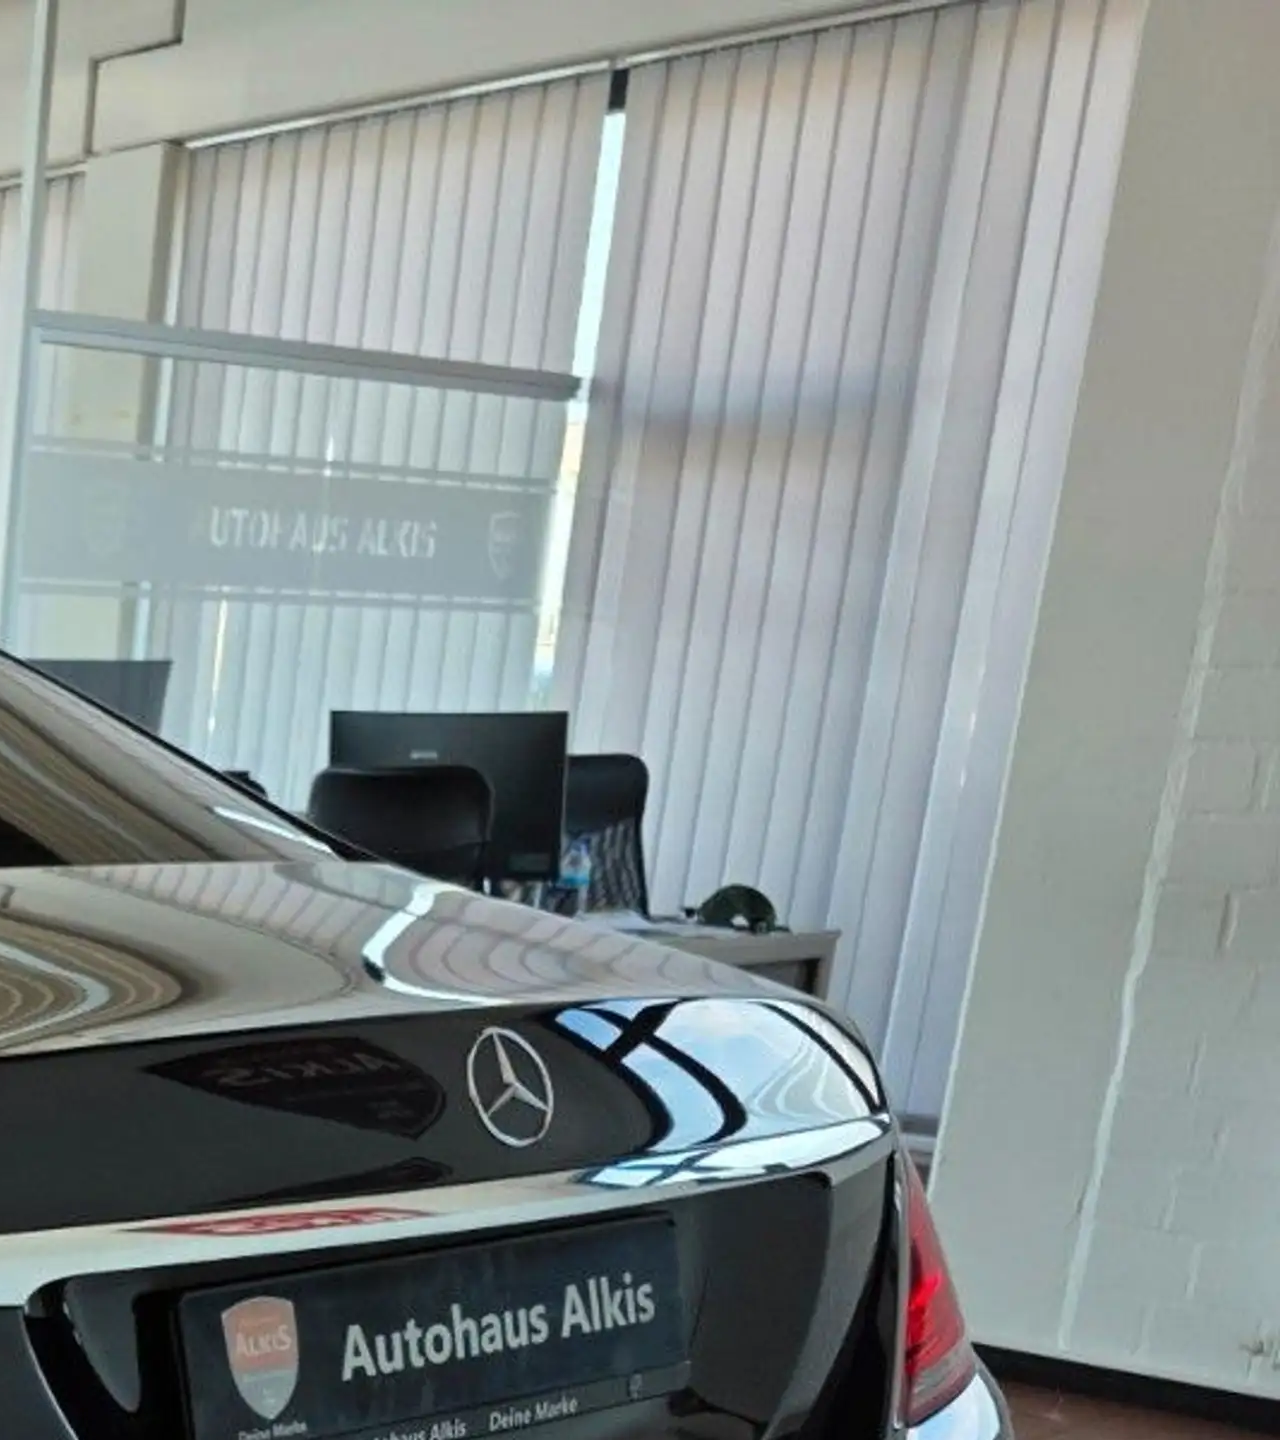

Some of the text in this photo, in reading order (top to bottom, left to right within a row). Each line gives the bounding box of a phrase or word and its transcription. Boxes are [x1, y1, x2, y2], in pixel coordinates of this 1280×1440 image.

[190, 506, 349, 554] UTOAUS
[342, 1271, 656, 1381] Autohaus Alkis
[489, 1405, 531, 1433] Deine
[534, 1396, 578, 1421] Marke
